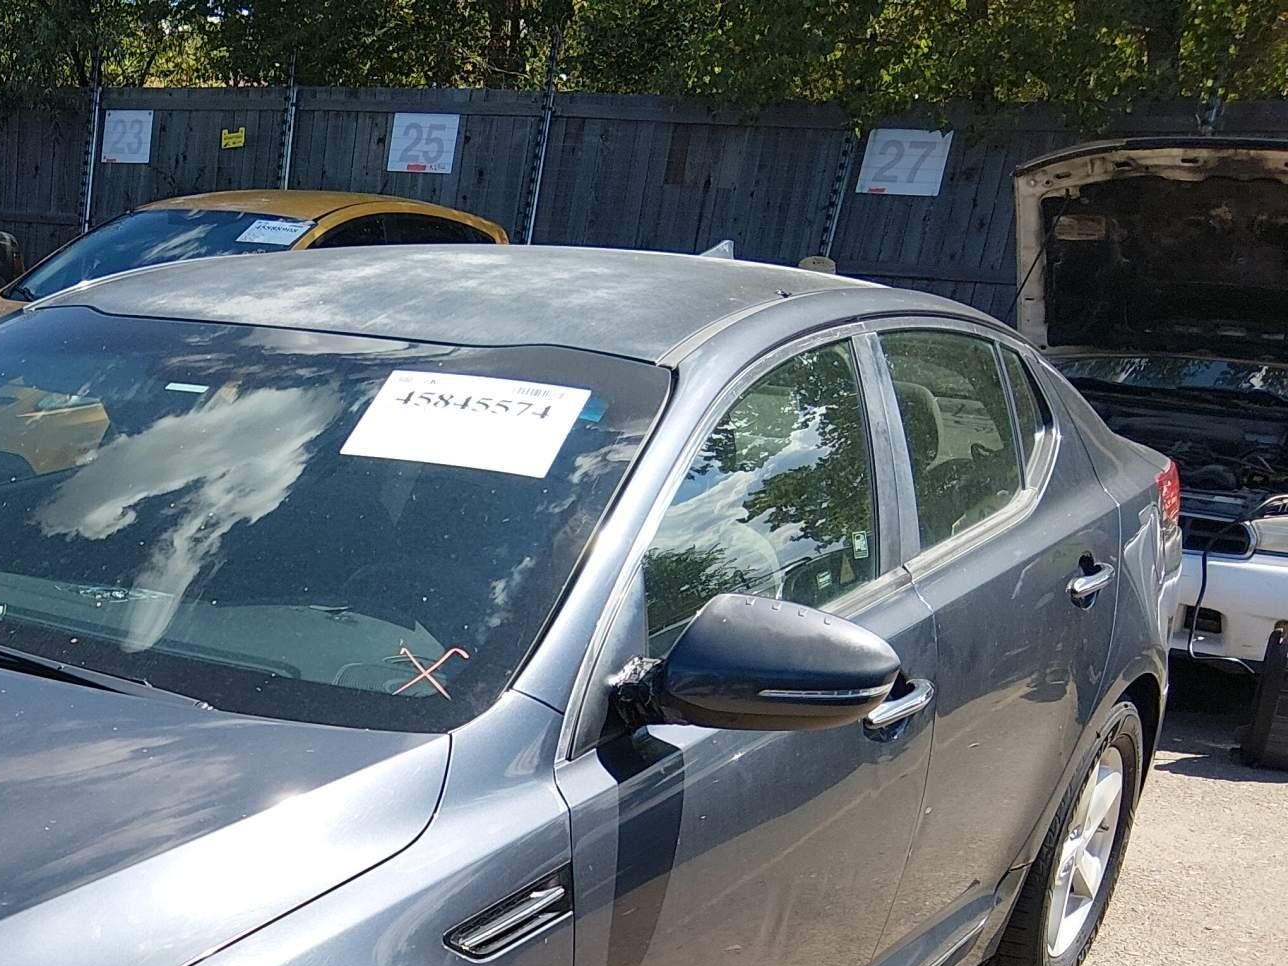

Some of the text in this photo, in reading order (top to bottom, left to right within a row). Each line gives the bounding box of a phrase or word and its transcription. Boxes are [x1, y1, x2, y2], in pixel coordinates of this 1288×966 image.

[112, 118, 144, 155] 23
[399, 122, 447, 163] 25
[872, 139, 937, 183] 27
[395, 390, 553, 420] 45845574
